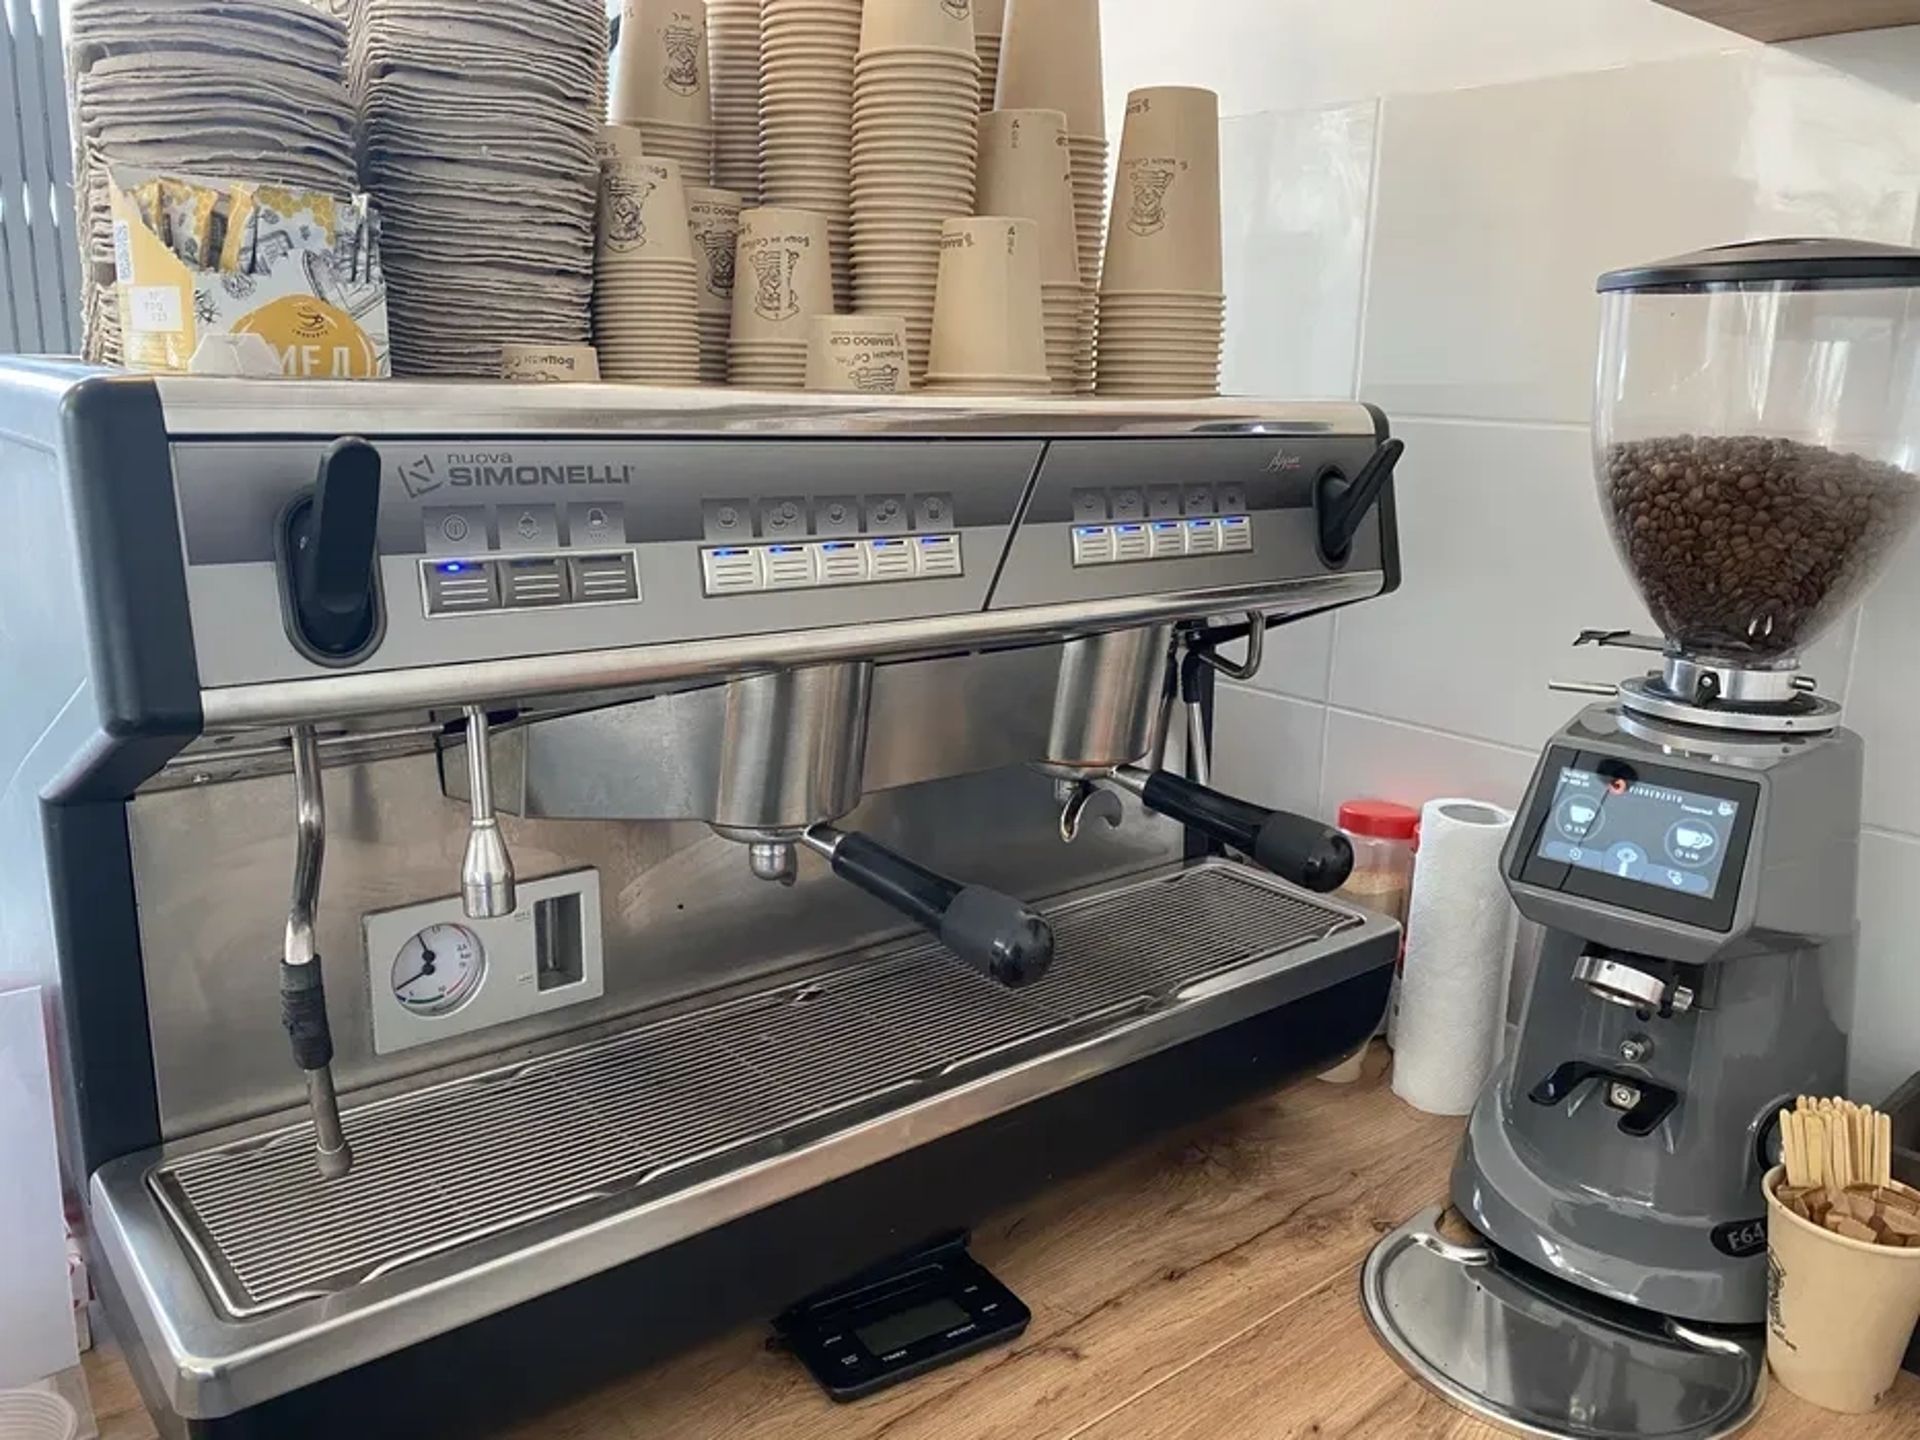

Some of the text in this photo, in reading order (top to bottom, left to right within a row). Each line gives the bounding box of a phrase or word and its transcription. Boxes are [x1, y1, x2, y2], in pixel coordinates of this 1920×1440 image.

[830, 337, 851, 346] CUP
[447, 453, 513, 464] nuova
[449, 464, 630, 487] SIMONELLI
